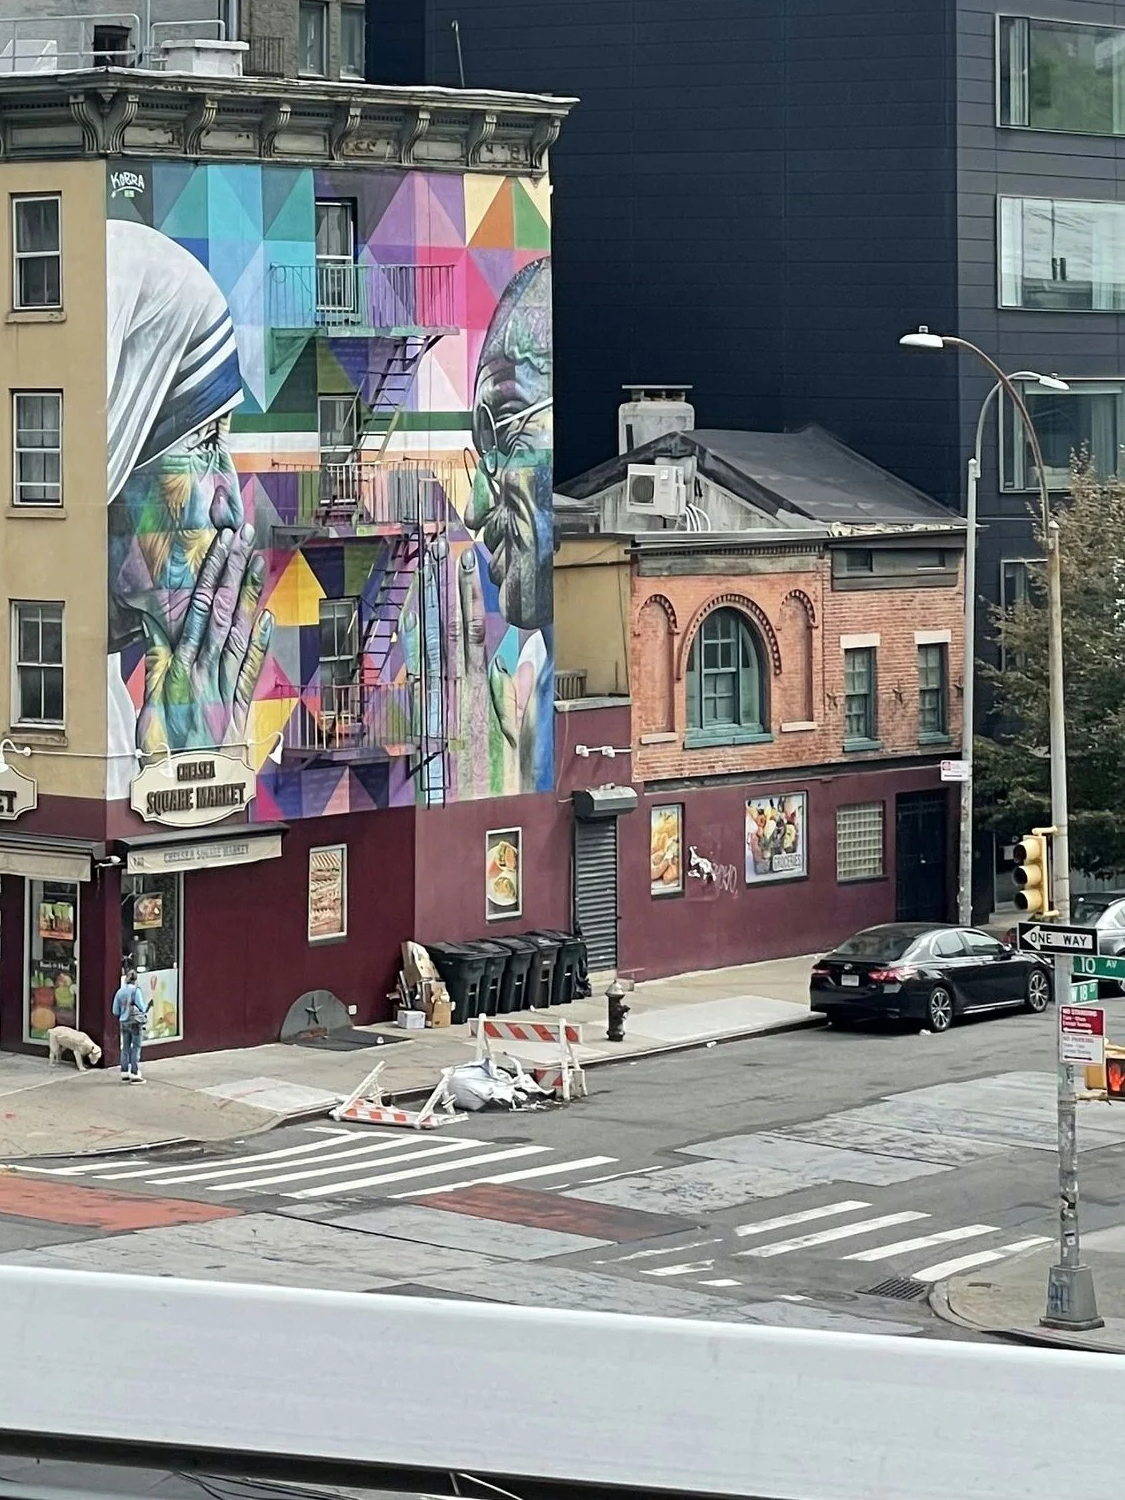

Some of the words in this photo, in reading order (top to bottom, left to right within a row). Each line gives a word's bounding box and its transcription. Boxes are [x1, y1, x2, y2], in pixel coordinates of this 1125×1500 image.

[110, 171, 145, 189] KOBRA
[177, 761, 216, 781] CHELSEA
[146, 787, 194, 816] SQUARE
[196, 782, 246, 809] MARKET
[1030, 932, 1053, 945] ONE
[1063, 934, 1087, 947] WAY
[1080, 957, 1096, 974] 10
[1106, 959, 1118, 969] AV
[1080, 985, 1088, 1001] 18
